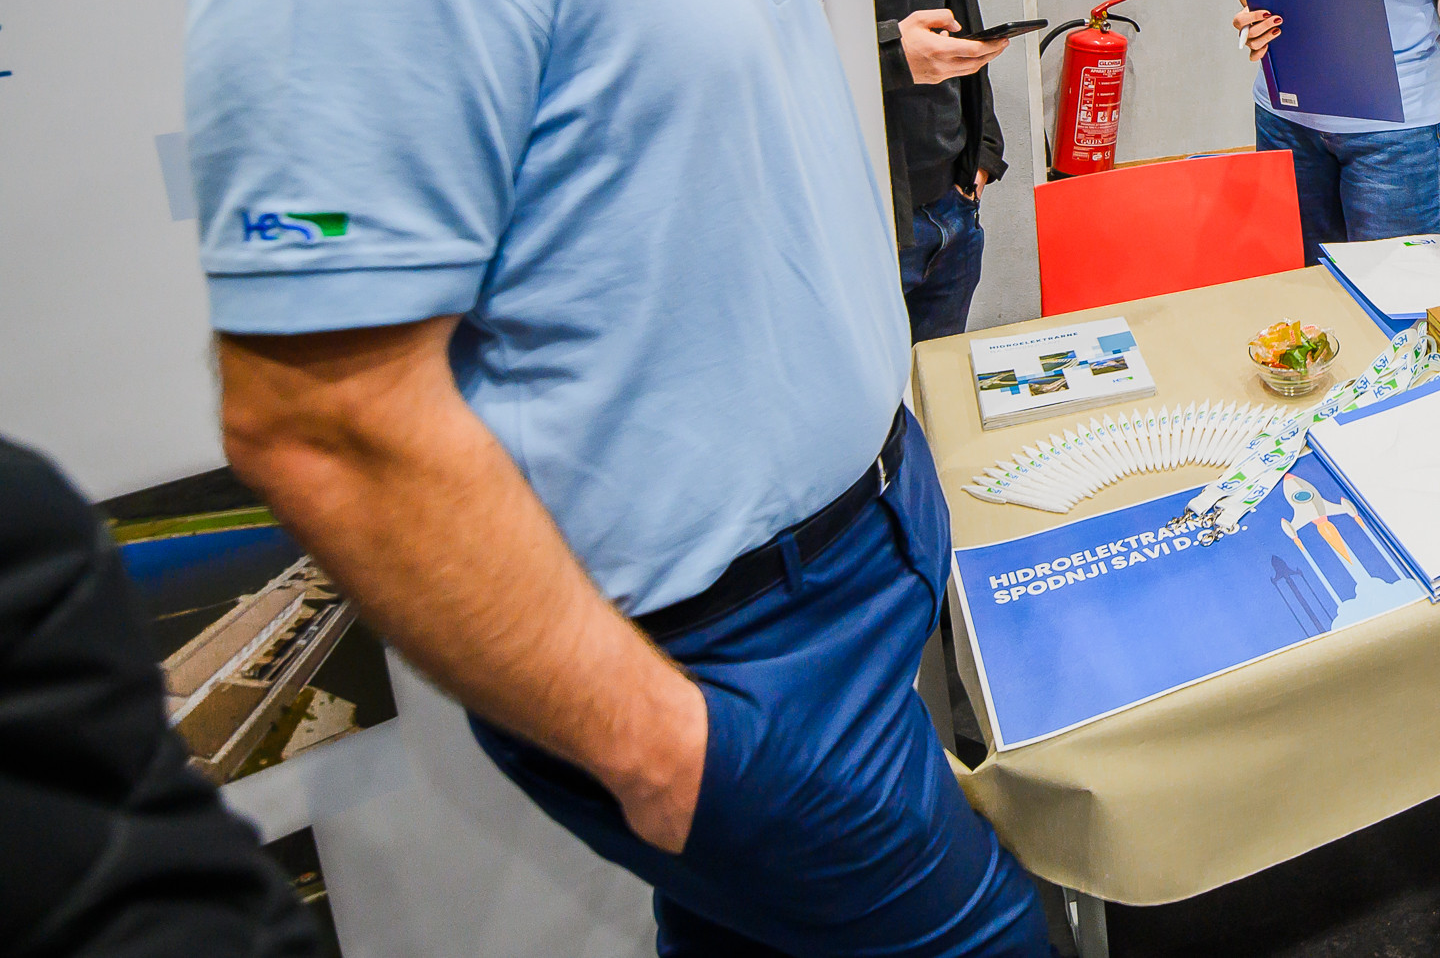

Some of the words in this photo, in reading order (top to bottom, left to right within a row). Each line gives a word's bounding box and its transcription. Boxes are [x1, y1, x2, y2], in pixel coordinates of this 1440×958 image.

[989, 332, 1079, 350] HIDROELEKTRARNE
[989, 516, 1212, 590] HIDROELEKTRARN
[993, 560, 1109, 606] SPODNJI
[1110, 542, 1171, 571] SAVI
